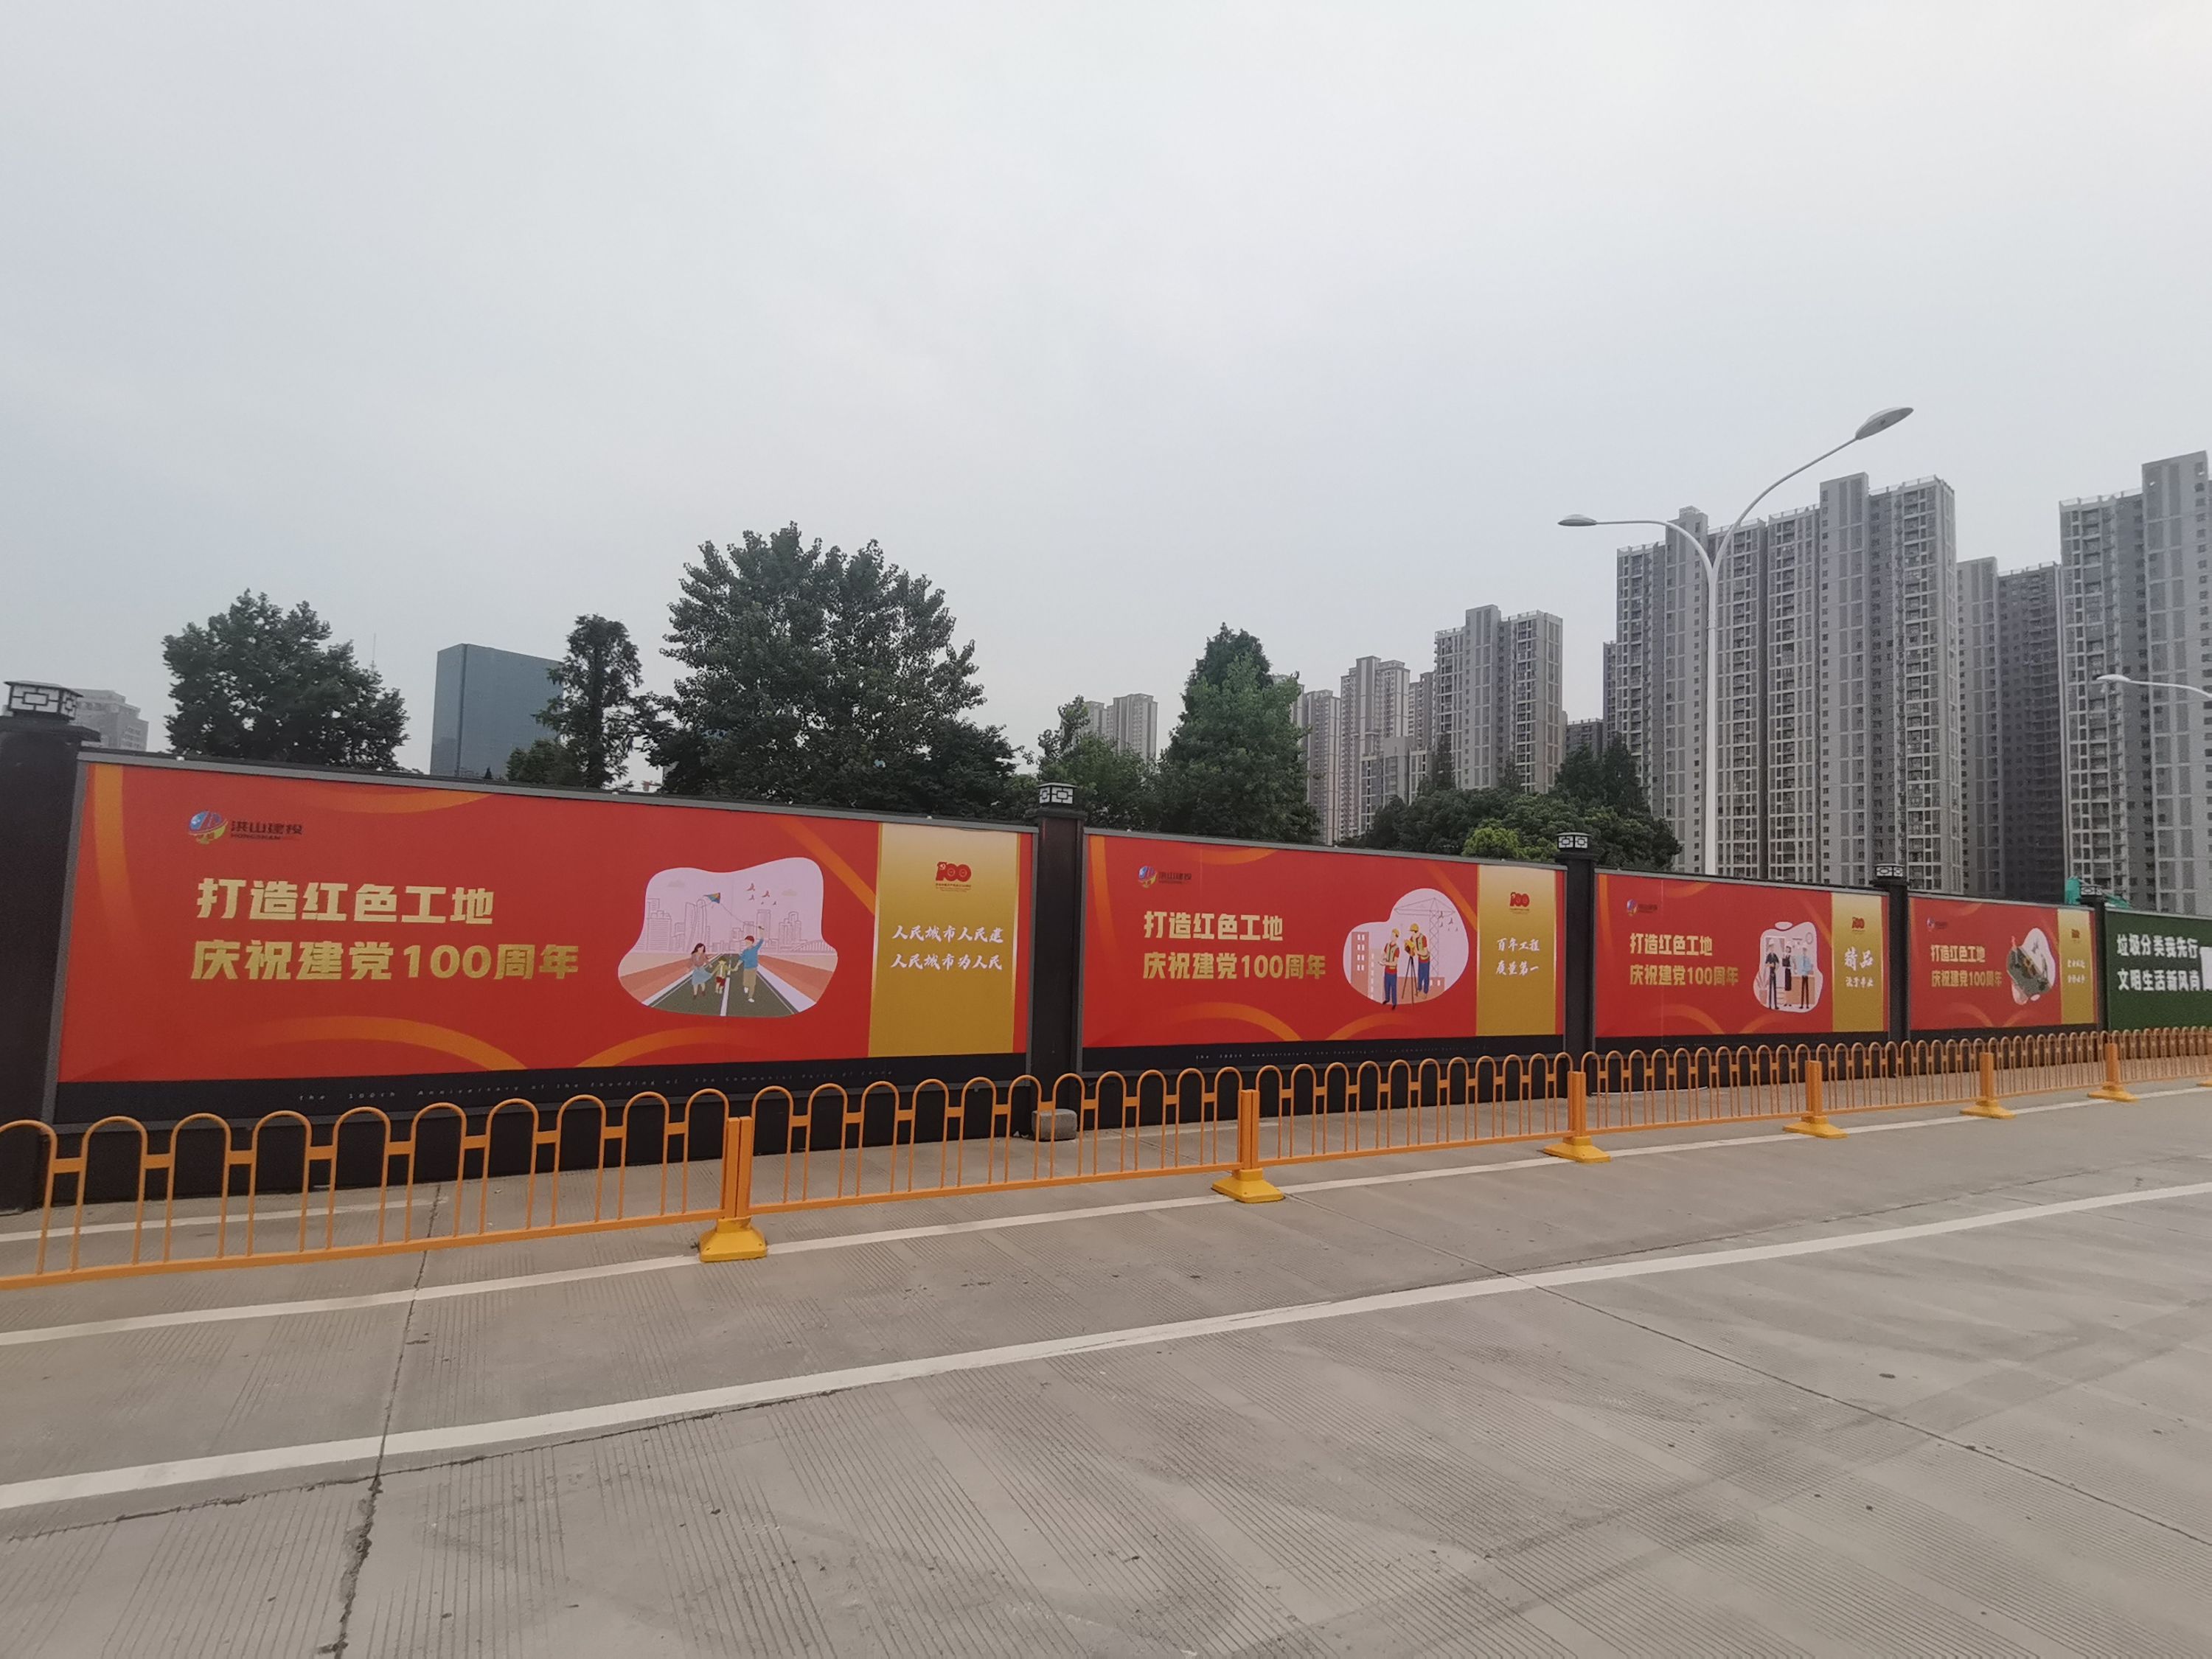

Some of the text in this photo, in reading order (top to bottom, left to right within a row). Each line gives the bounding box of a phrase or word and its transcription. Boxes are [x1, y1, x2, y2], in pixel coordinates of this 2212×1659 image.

[196, 878, 495, 925] 打造红色工地
[891, 925, 1004, 943] 人民城市人民建
[1144, 911, 1284, 942] 打造红色工地
[1630, 933, 1713, 956] 打造红色工地
[1930, 945, 1986, 963] 打造红色工地
[190, 939, 579, 980] 庆祝建党100周年
[891, 953, 1003, 971] 人民城市为人民
[1143, 952, 1326, 980] 庆祝建党100周年
[1629, 964, 1739, 986] 庆祝建党100周年
[1931, 970, 2003, 987] 庆祝建党100周年
[2117, 968, 2200, 992] 文明生活新风尚
